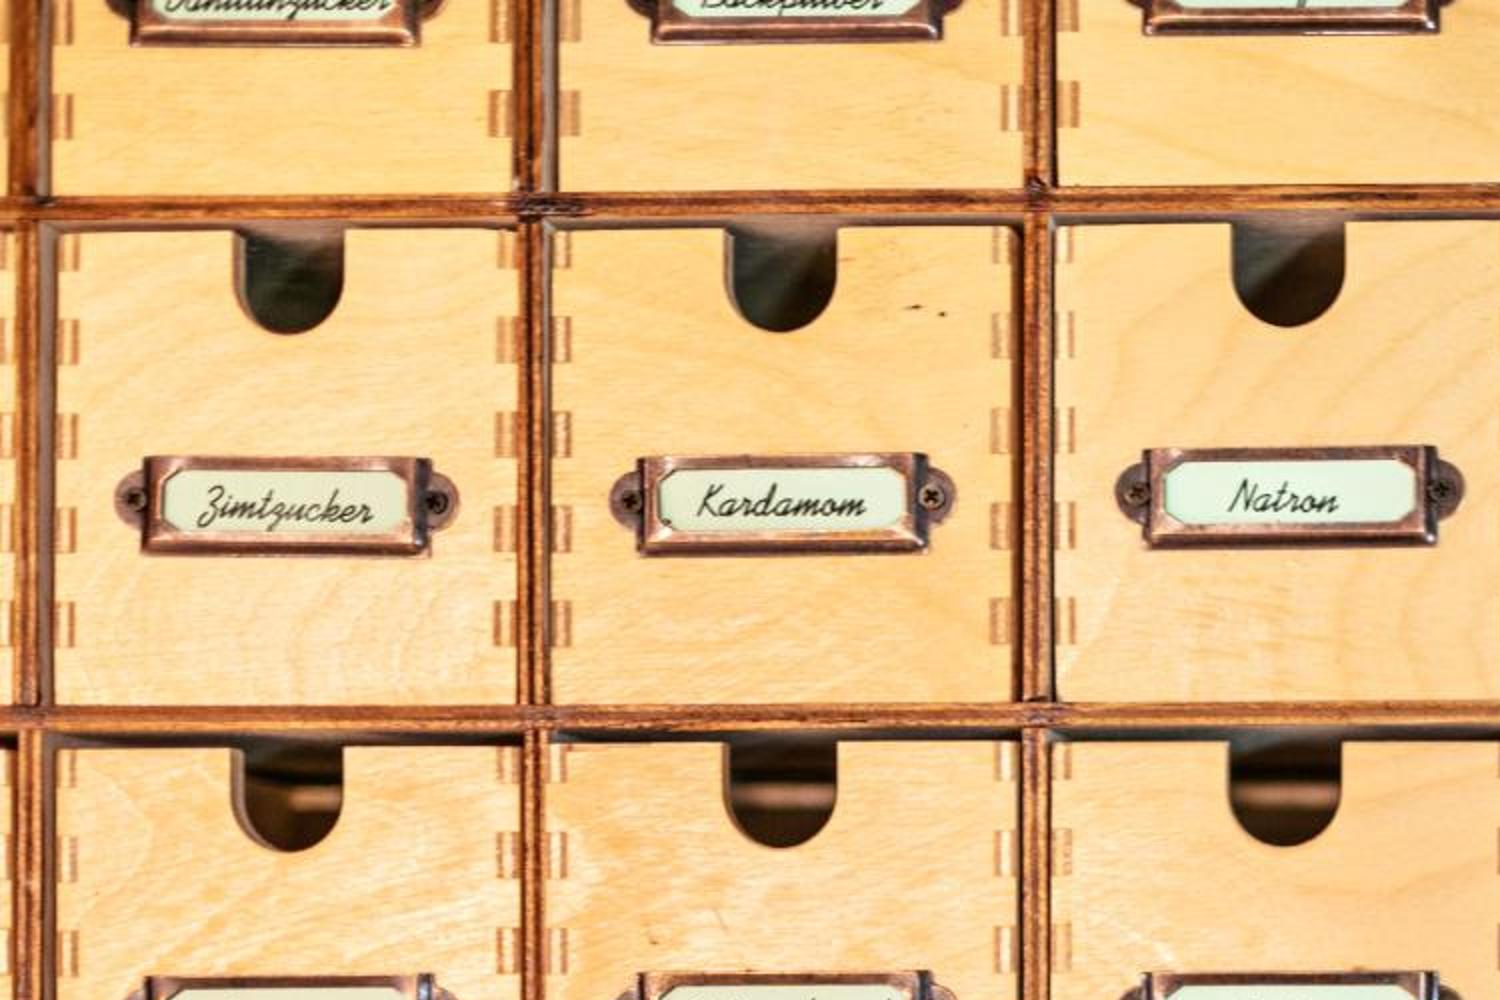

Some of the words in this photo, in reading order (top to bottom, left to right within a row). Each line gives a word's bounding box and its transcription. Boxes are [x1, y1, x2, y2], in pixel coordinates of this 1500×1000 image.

[197, 485, 375, 532] Zimtzucker
[697, 483, 867, 517] Kardamom
[1228, 478, 1339, 513] Natron
